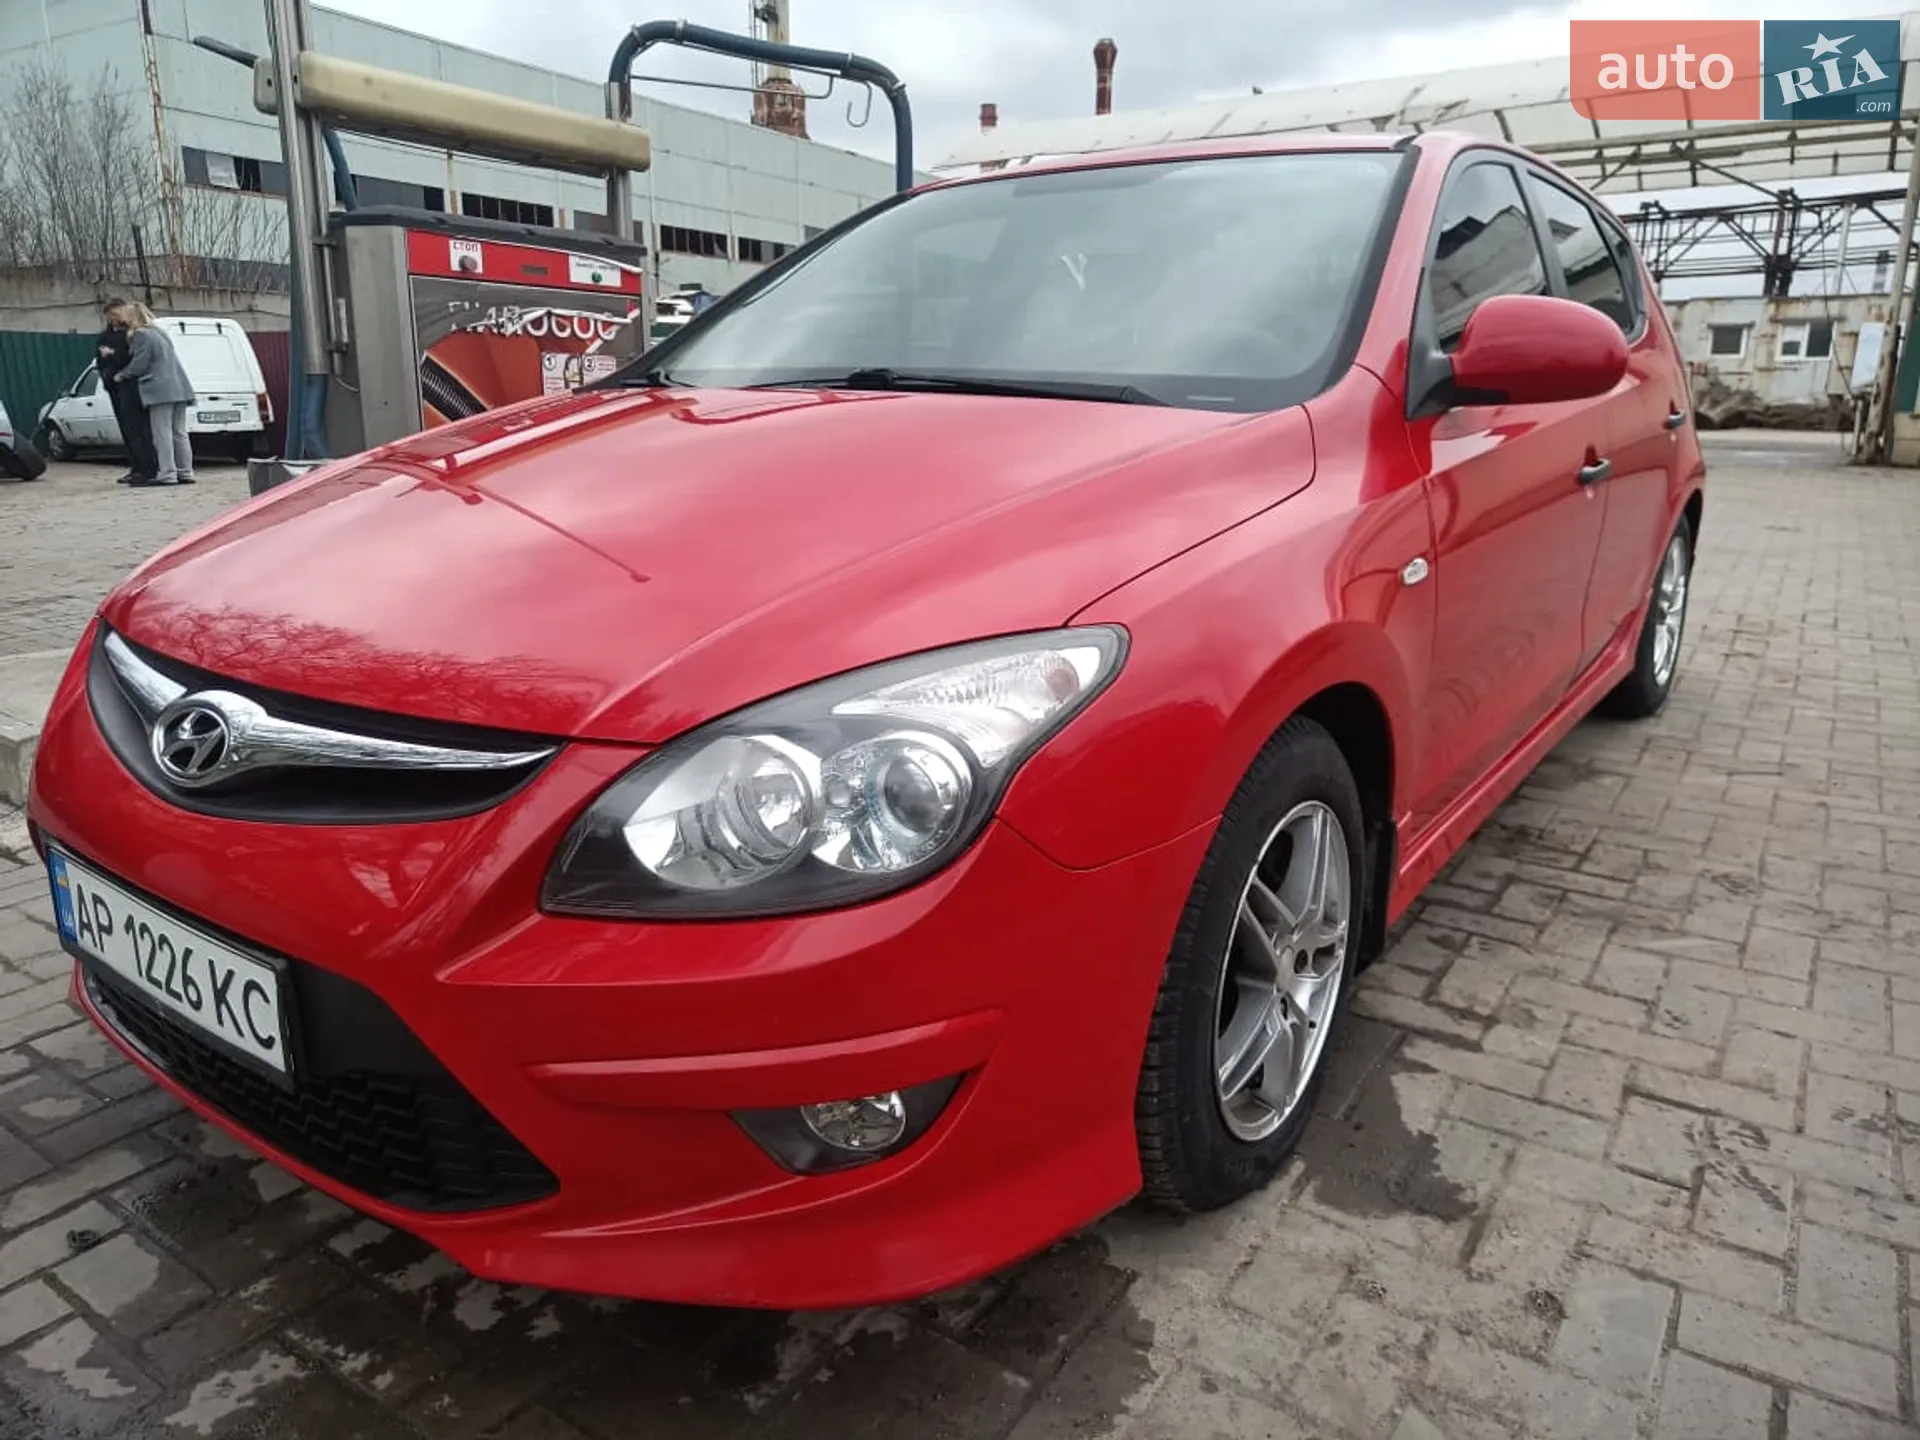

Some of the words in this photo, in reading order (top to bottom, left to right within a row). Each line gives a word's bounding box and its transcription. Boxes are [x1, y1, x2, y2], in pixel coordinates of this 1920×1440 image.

[76, 883, 114, 953] AP
[124, 914, 203, 1012] 1226
[208, 958, 277, 1051] KC
